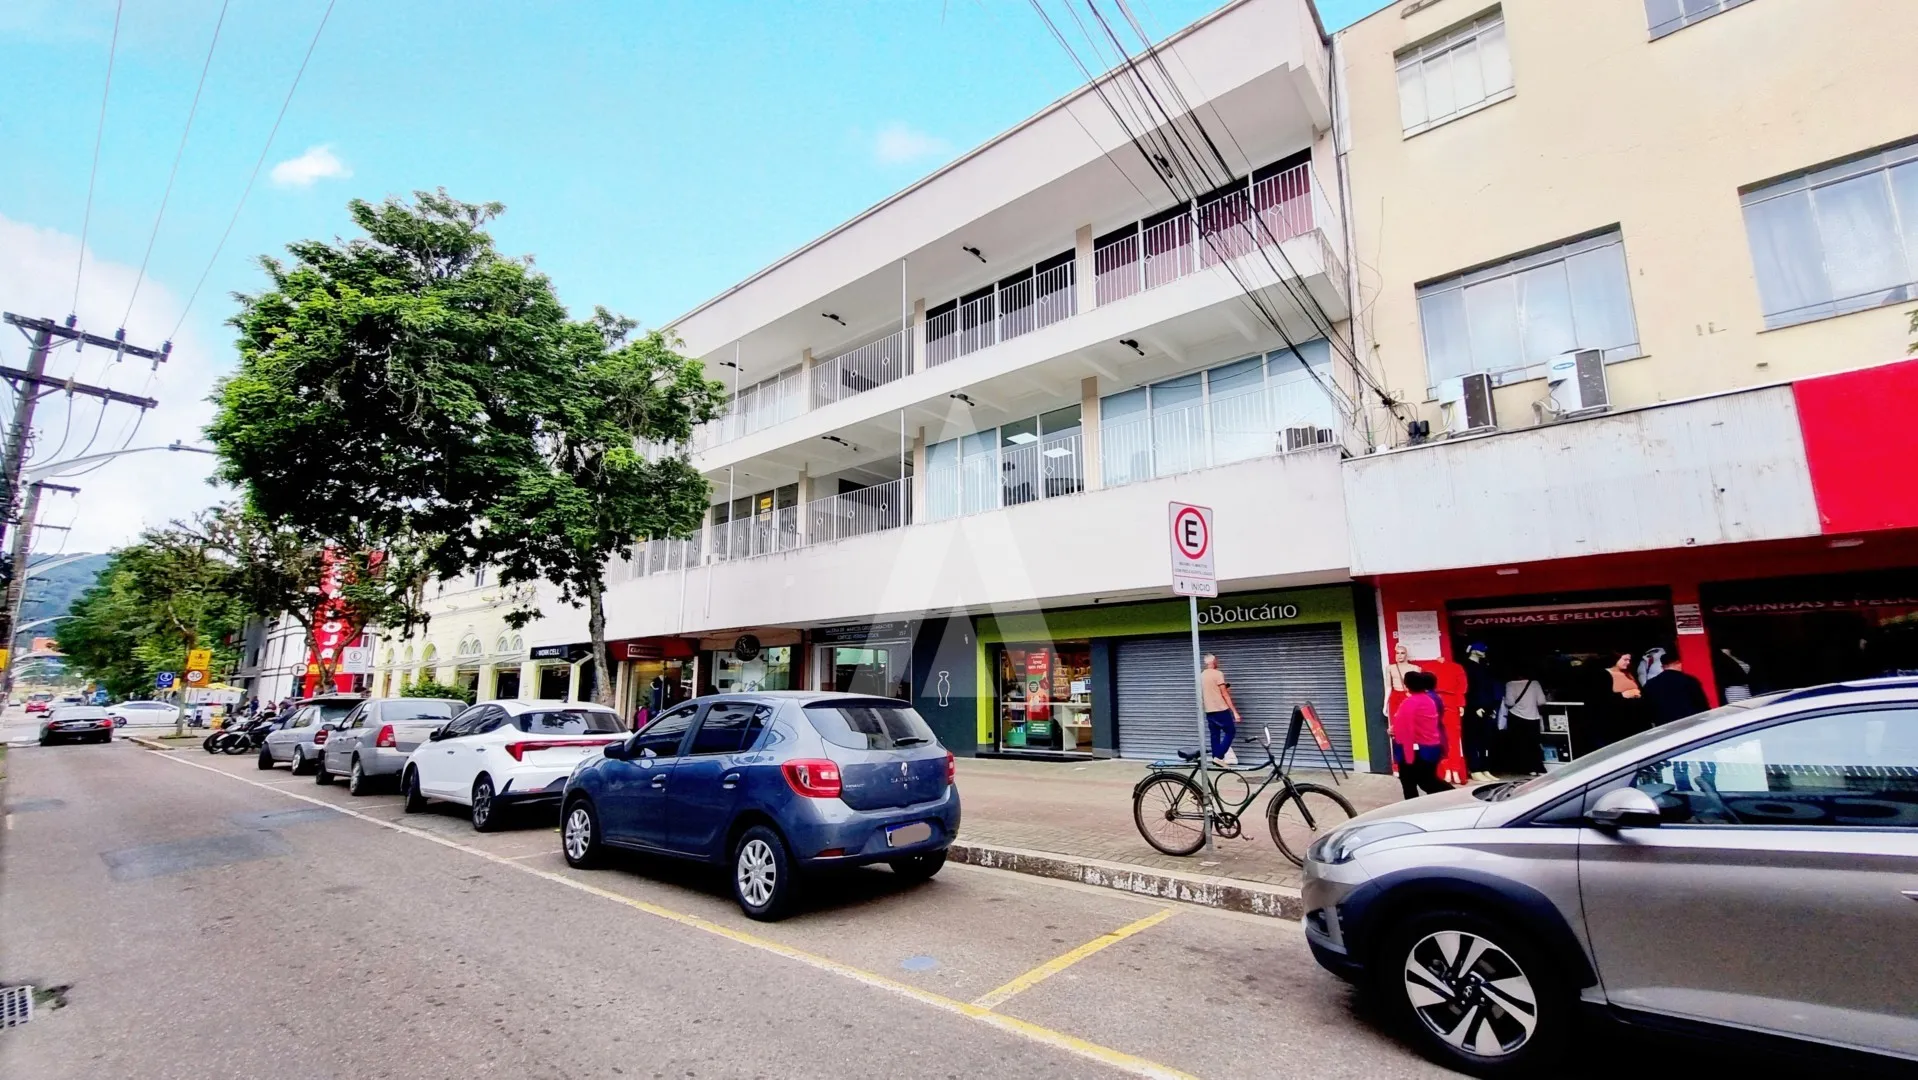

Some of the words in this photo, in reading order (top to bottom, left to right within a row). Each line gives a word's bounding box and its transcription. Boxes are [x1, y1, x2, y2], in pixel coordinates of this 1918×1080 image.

[1185, 519, 1198, 547] E
[1197, 603, 1297, 624] oBoticário
[1463, 614, 1545, 626] CAPINHAS
[1548, 613, 1559, 621] E
[1563, 608, 1660, 621] PELICULAS
